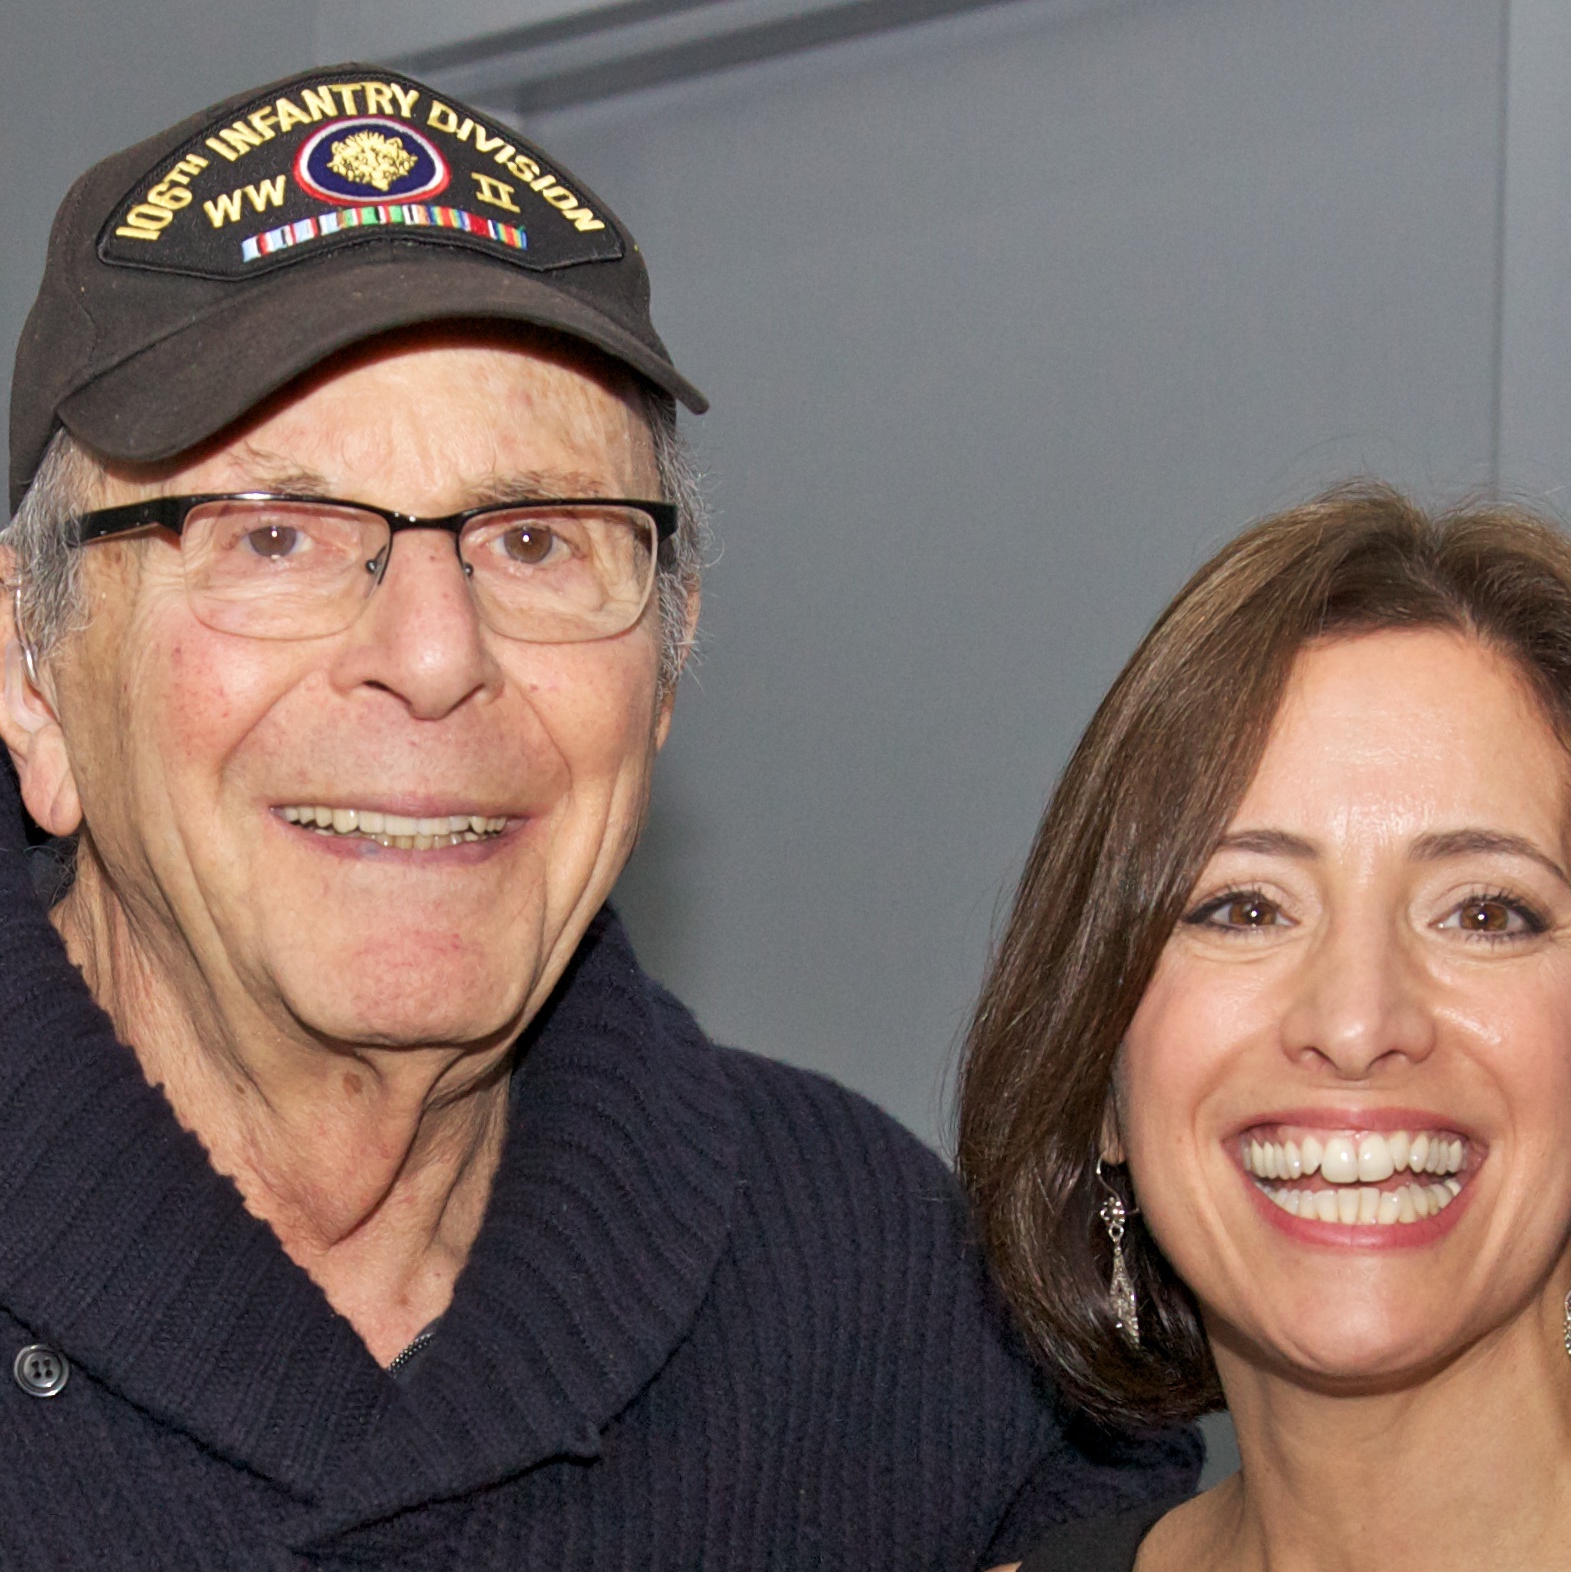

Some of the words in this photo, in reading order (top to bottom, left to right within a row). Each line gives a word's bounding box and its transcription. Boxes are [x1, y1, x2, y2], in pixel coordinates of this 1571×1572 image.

[115, 155, 208, 241] 106TH
[205, 82, 420, 162] INFANTRY
[427, 100, 605, 233] DIVISION
[204, 175, 287, 229] WW
[470, 172, 520, 213] II
